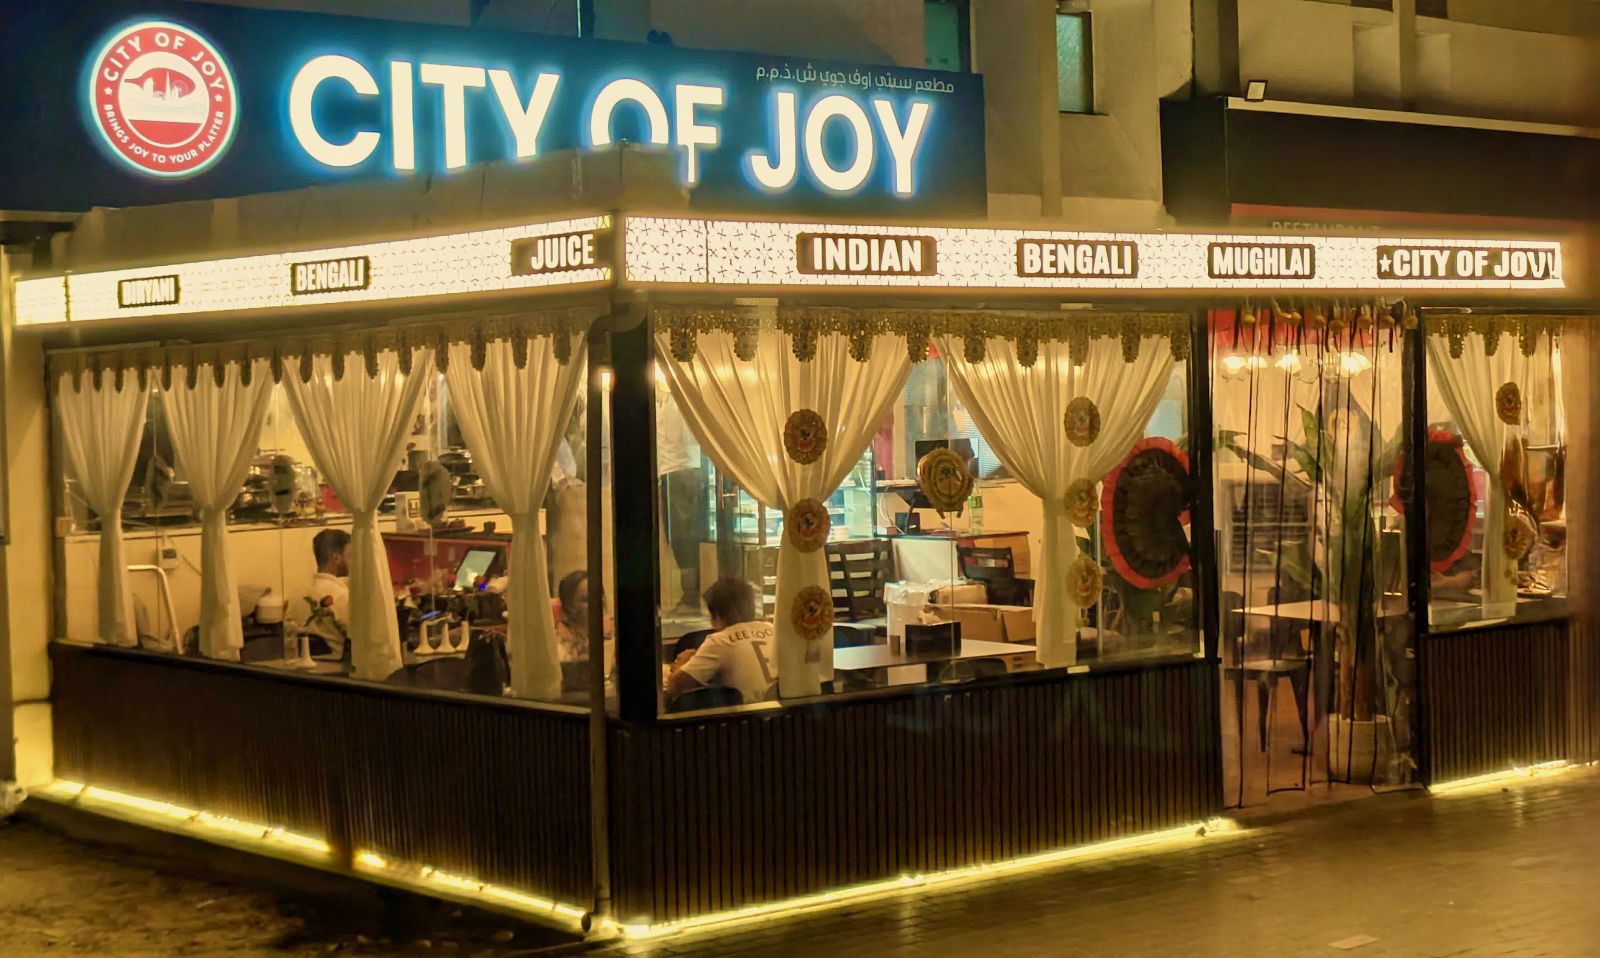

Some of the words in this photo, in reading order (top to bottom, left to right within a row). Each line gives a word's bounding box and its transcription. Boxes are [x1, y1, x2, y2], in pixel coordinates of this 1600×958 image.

[104, 36, 142, 81] CITY
[154, 32, 186, 49] OF
[191, 51, 225, 90] JOY
[914, 76, 954, 94] مطعم
[104, 104, 129, 144] BRINGS
[129, 143, 149, 158] JOY
[153, 153, 166, 163] TO
[170, 149, 198, 164] YOUR
[198, 111, 225, 151] PLATTER
[289, 54, 561, 170] CITY
[590, 78, 723, 184] OF
[751, 92, 929, 193] JOY
[1271, 220, 1381, 232] RESTAUR
[530, 233, 594, 270] JUICE
[813, 237, 922, 272] INDIAN
[1023, 242, 1133, 275] BENGALI
[1213, 246, 1311, 276] MUGHLAI
[1393, 249, 1450, 277] CITY
[1456, 250, 1488, 277] OF
[296, 258, 364, 292] BENGALI
